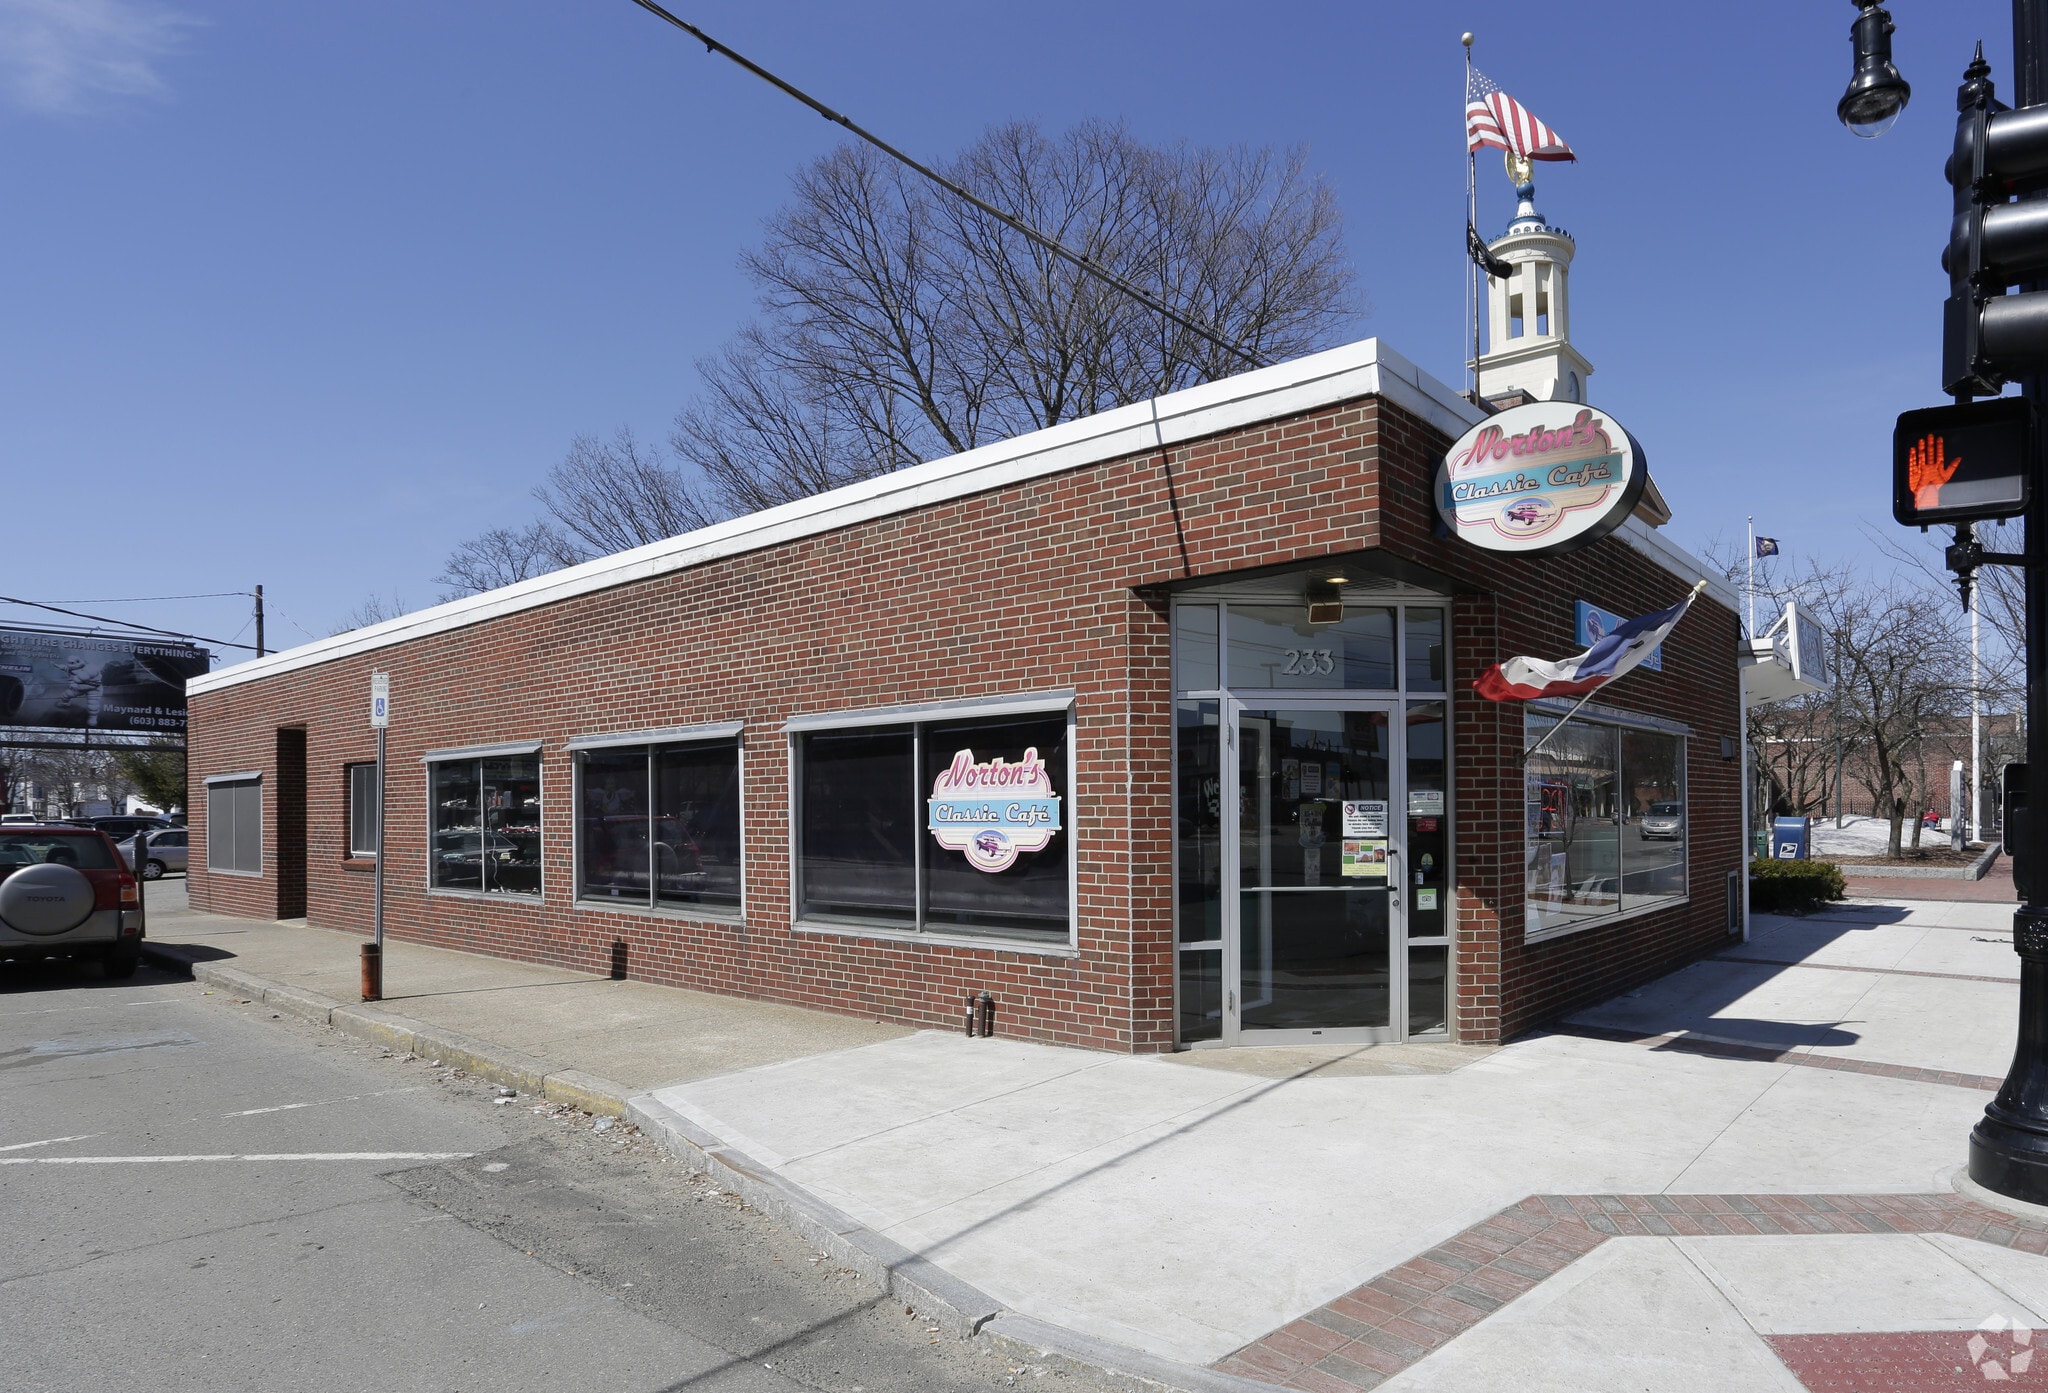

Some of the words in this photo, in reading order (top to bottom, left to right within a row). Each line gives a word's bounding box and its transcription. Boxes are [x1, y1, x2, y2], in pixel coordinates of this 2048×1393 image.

[1463, 408, 1603, 467] Norton's
[1451, 474, 1540, 502] Classic
[1547, 462, 1611, 487] Café
[31, 637, 60, 648] TIRE
[63, 640, 119, 652] CHANGES
[0, 664, 32, 673] HELIN
[1282, 648, 1335, 675] 233
[103, 704, 152, 715] Maynard
[154, 707, 163, 715] &
[129, 716, 156, 727] (603)
[944, 750, 1040, 787] Norton's
[935, 804, 1000, 823] Classic
[1005, 803, 1051, 827] Café
